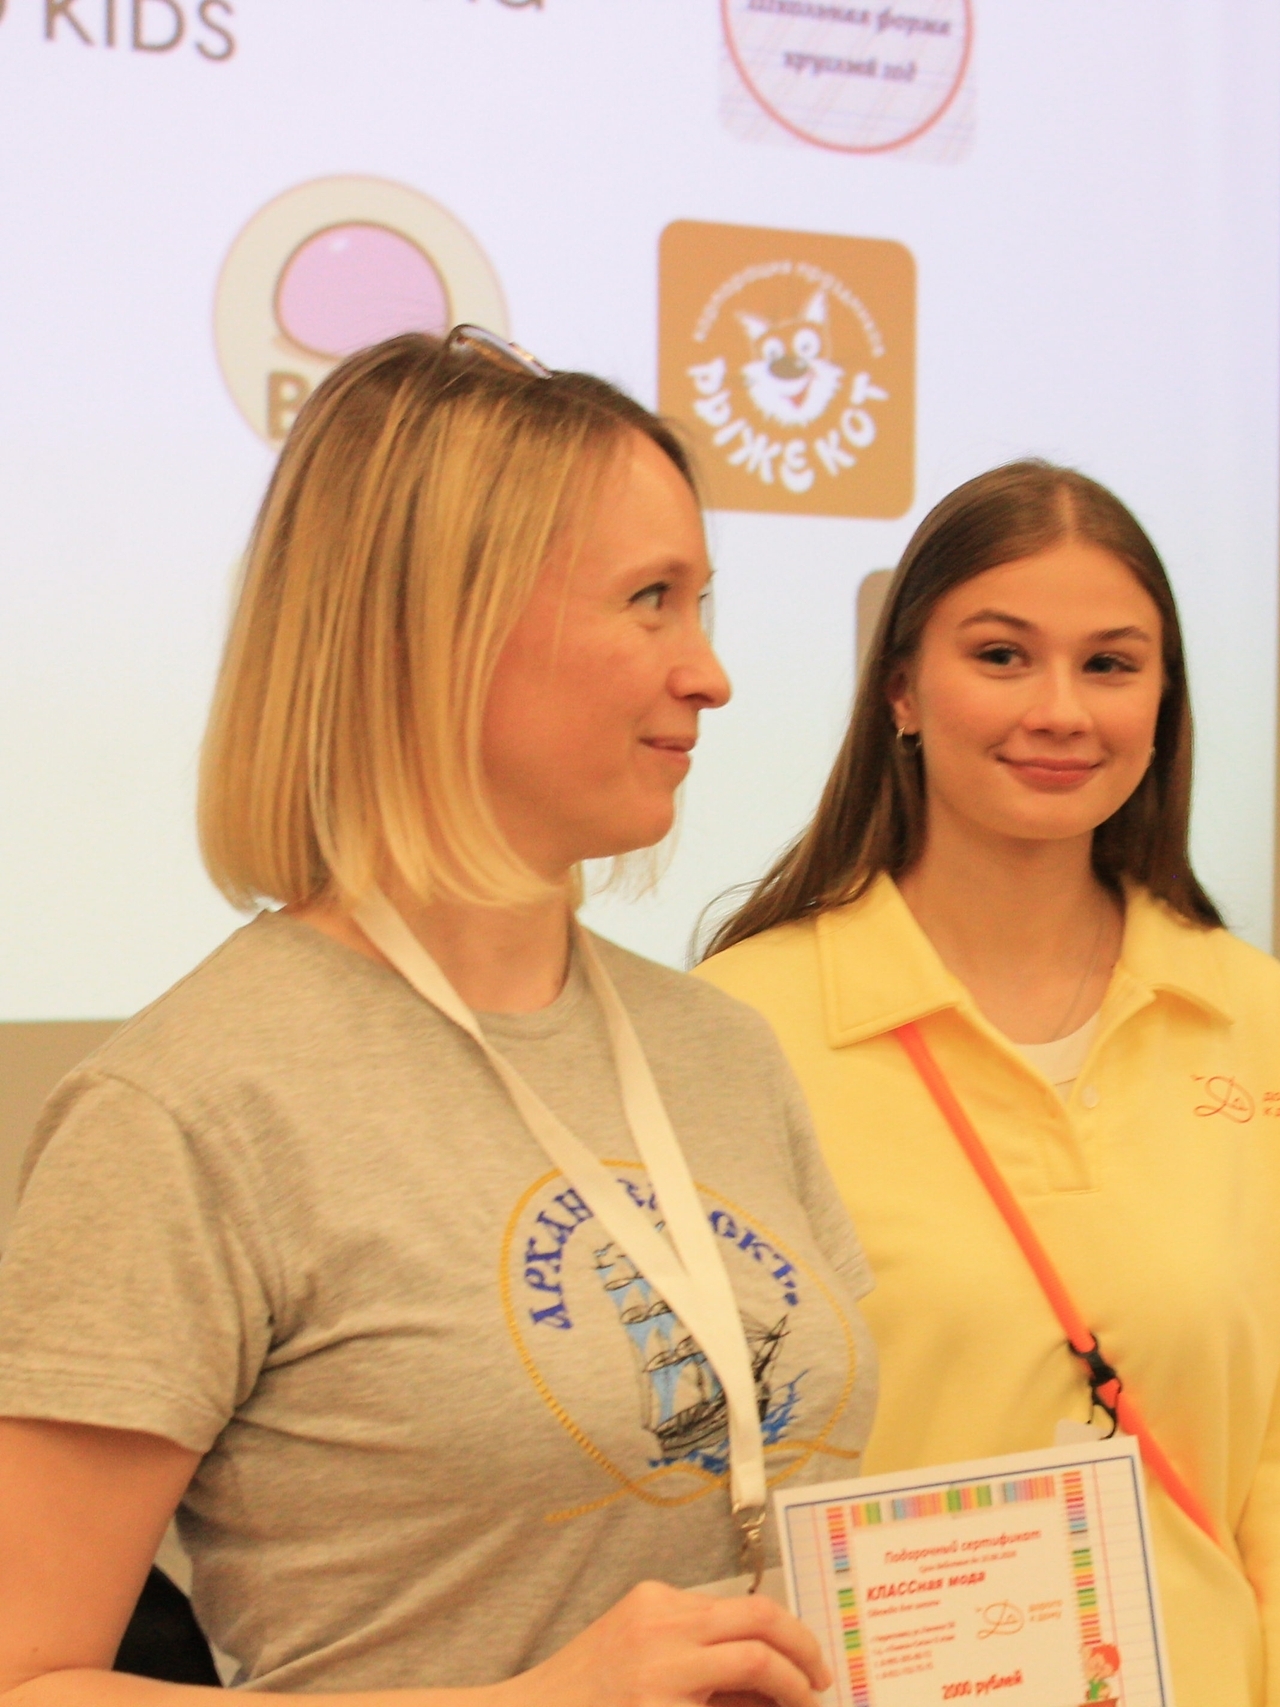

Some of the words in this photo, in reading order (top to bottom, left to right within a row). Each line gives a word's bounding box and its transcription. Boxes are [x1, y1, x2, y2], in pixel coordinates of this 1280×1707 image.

[44, 0, 236, 62] KIDS
[884, 1540, 959, 1564] Подарочный
[961, 1530, 1042, 1551] сертификат
[866, 1578, 944, 1601] КЛАССная
[948, 1571, 987, 1587] мода
[942, 1680, 972, 1700] 2000
[976, 1669, 1023, 1695] рублей
